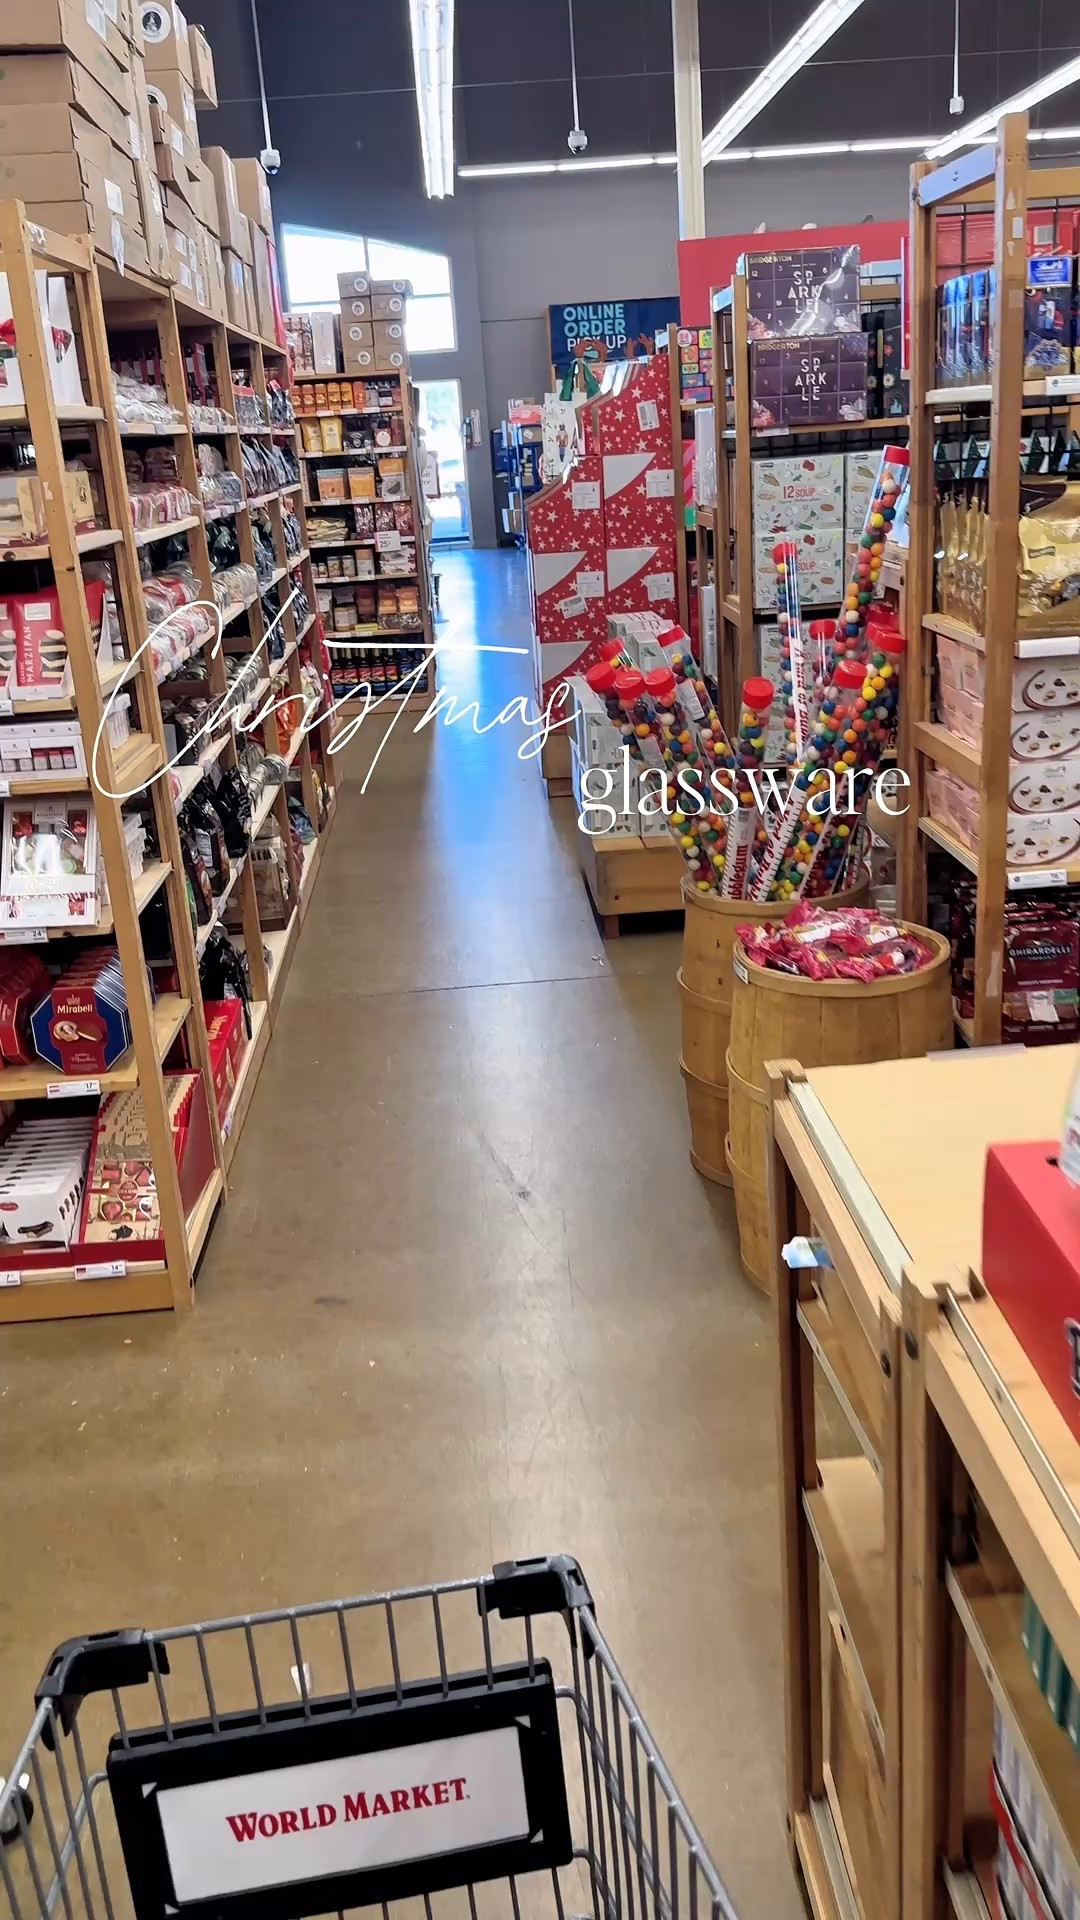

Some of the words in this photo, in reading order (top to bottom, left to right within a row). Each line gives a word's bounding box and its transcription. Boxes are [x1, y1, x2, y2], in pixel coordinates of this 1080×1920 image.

[751, 270, 758, 278] 12
[563, 303, 625, 321] ONLINE
[564, 318, 626, 338] ORDER
[606, 334, 627, 349] UP
[795, 372, 827, 387] ARK
[801, 386, 820, 402] LE
[783, 485, 795, 499] 12
[795, 487, 816, 498] SOUP
[797, 561, 816, 571] SOUP
[22, 626, 35, 683] MARZIPAN
[57, 1003, 93, 1014] Mirabell
[225, 1803, 337, 1843] WORLD
[343, 1777, 467, 1823] MARKET
